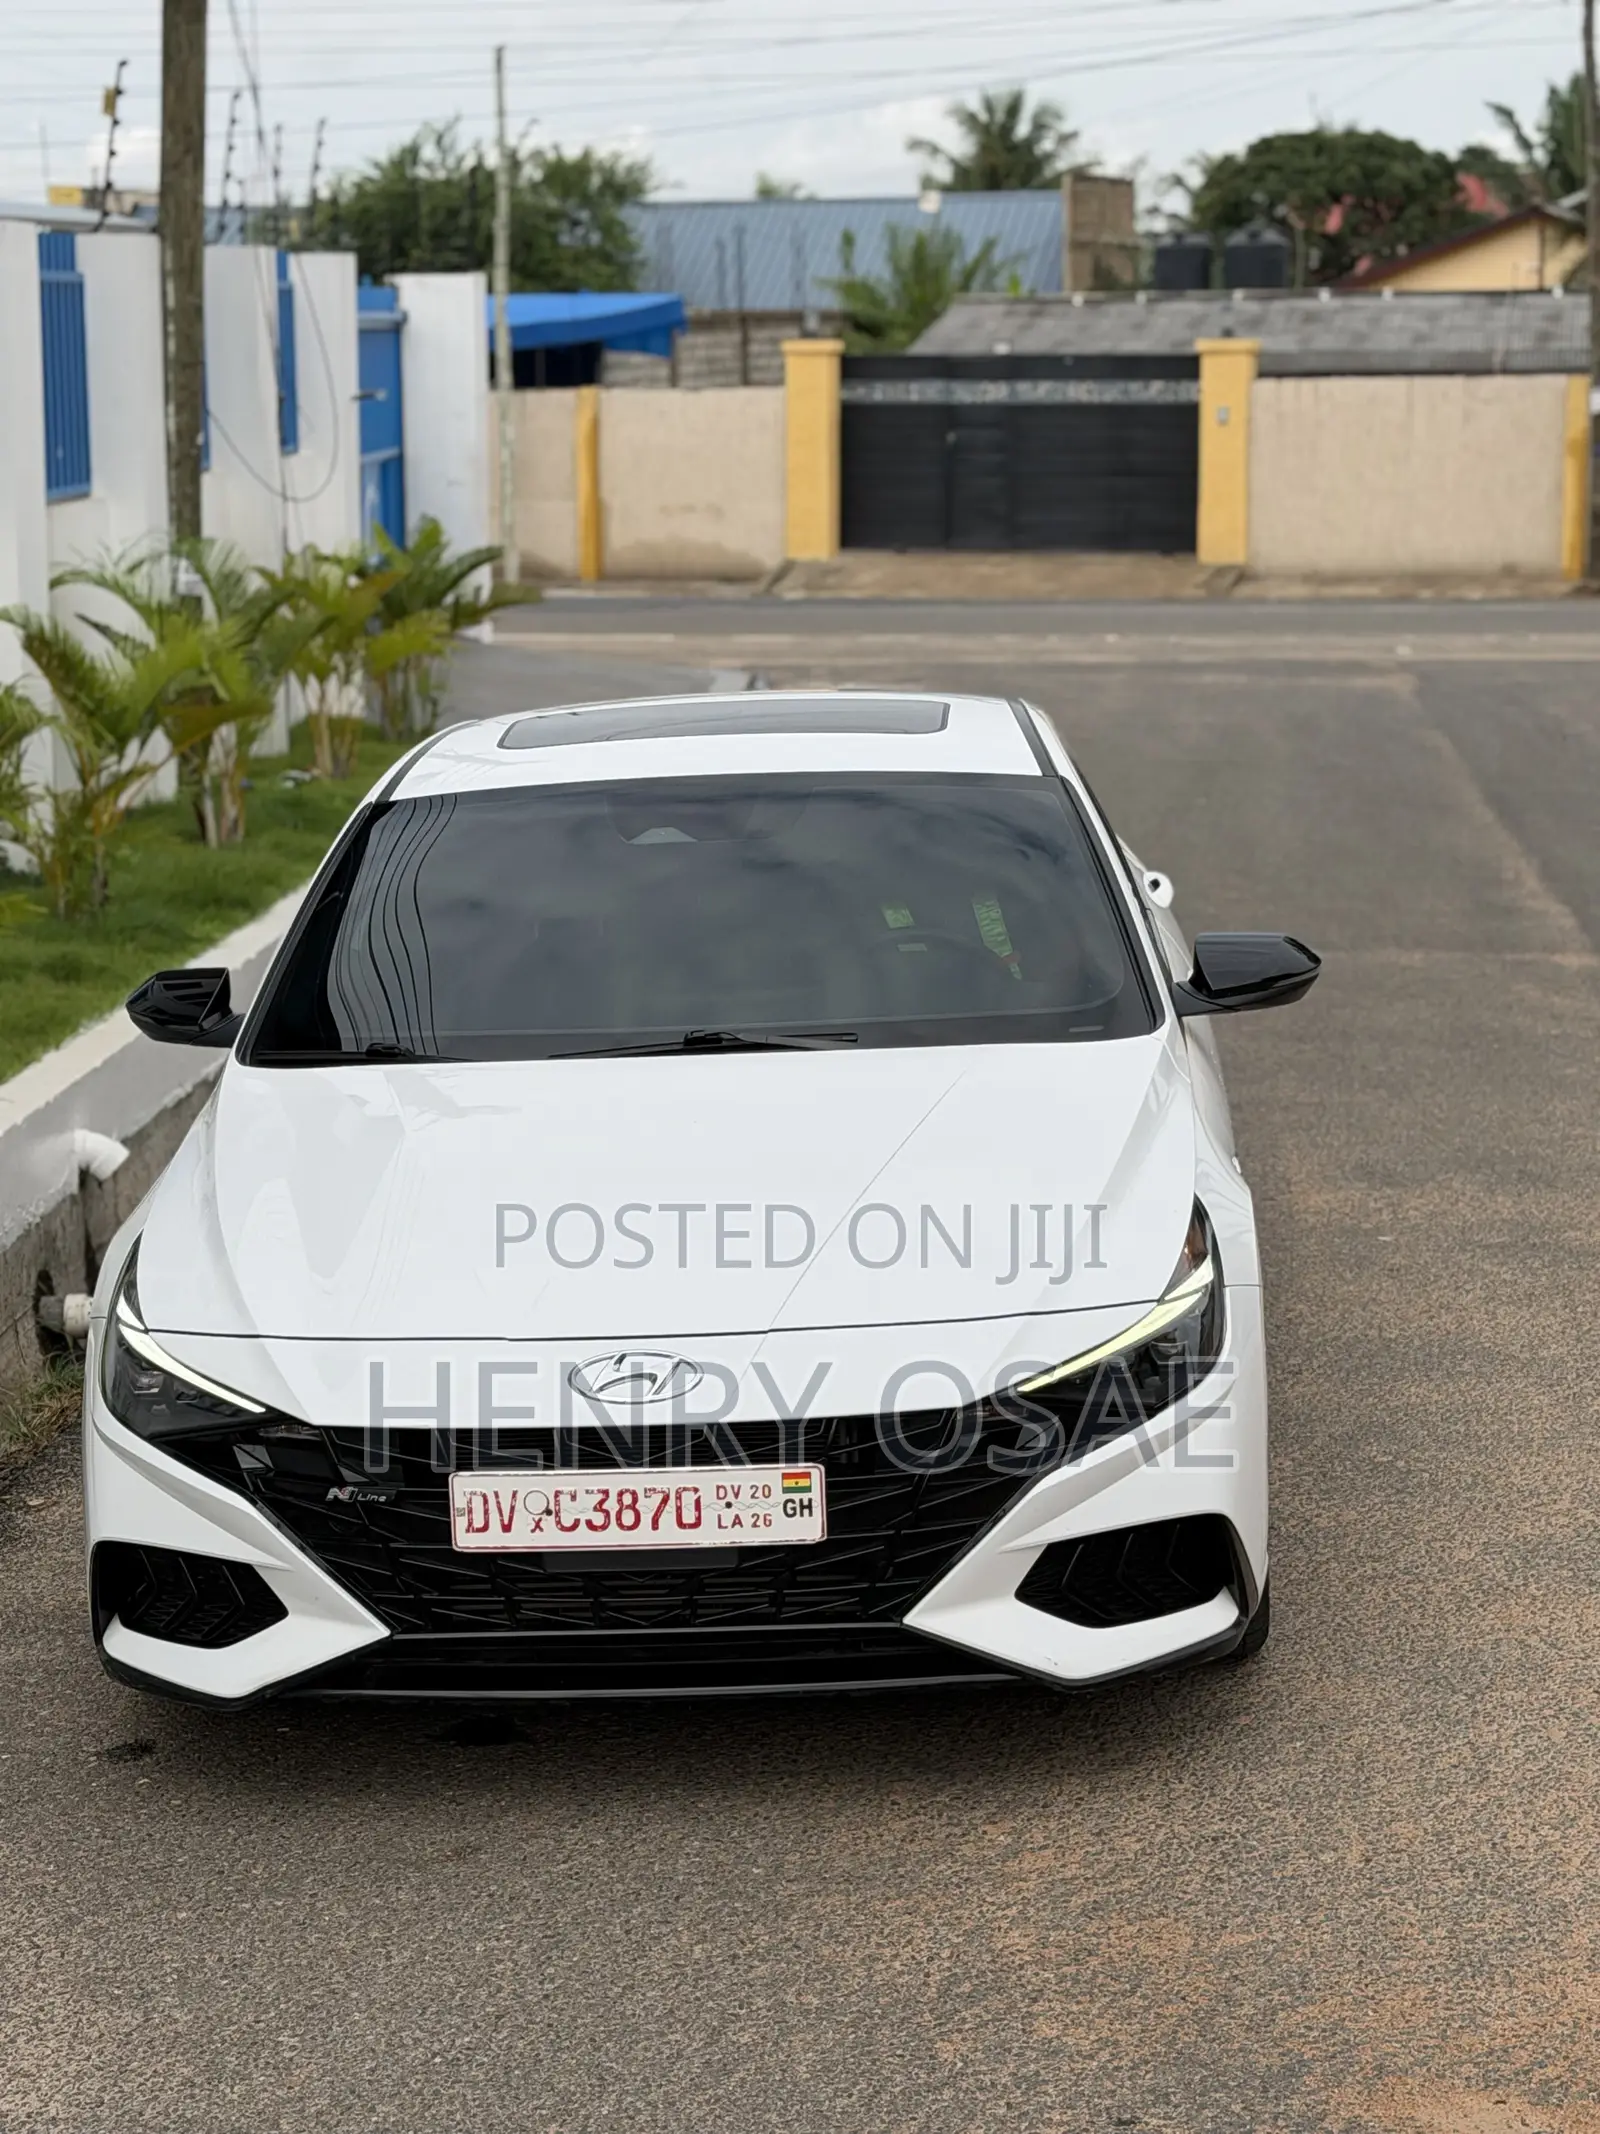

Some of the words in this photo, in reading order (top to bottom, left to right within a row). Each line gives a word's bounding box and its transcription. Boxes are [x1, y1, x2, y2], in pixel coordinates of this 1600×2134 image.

[716, 1484, 742, 1501] DV
[749, 1483, 772, 1500] 20
[463, 1488, 518, 1534] DV
[553, 1486, 703, 1533] C3870
[782, 1497, 814, 1519] GH
[717, 1513, 744, 1530] LA
[750, 1512, 773, 1529] 26
